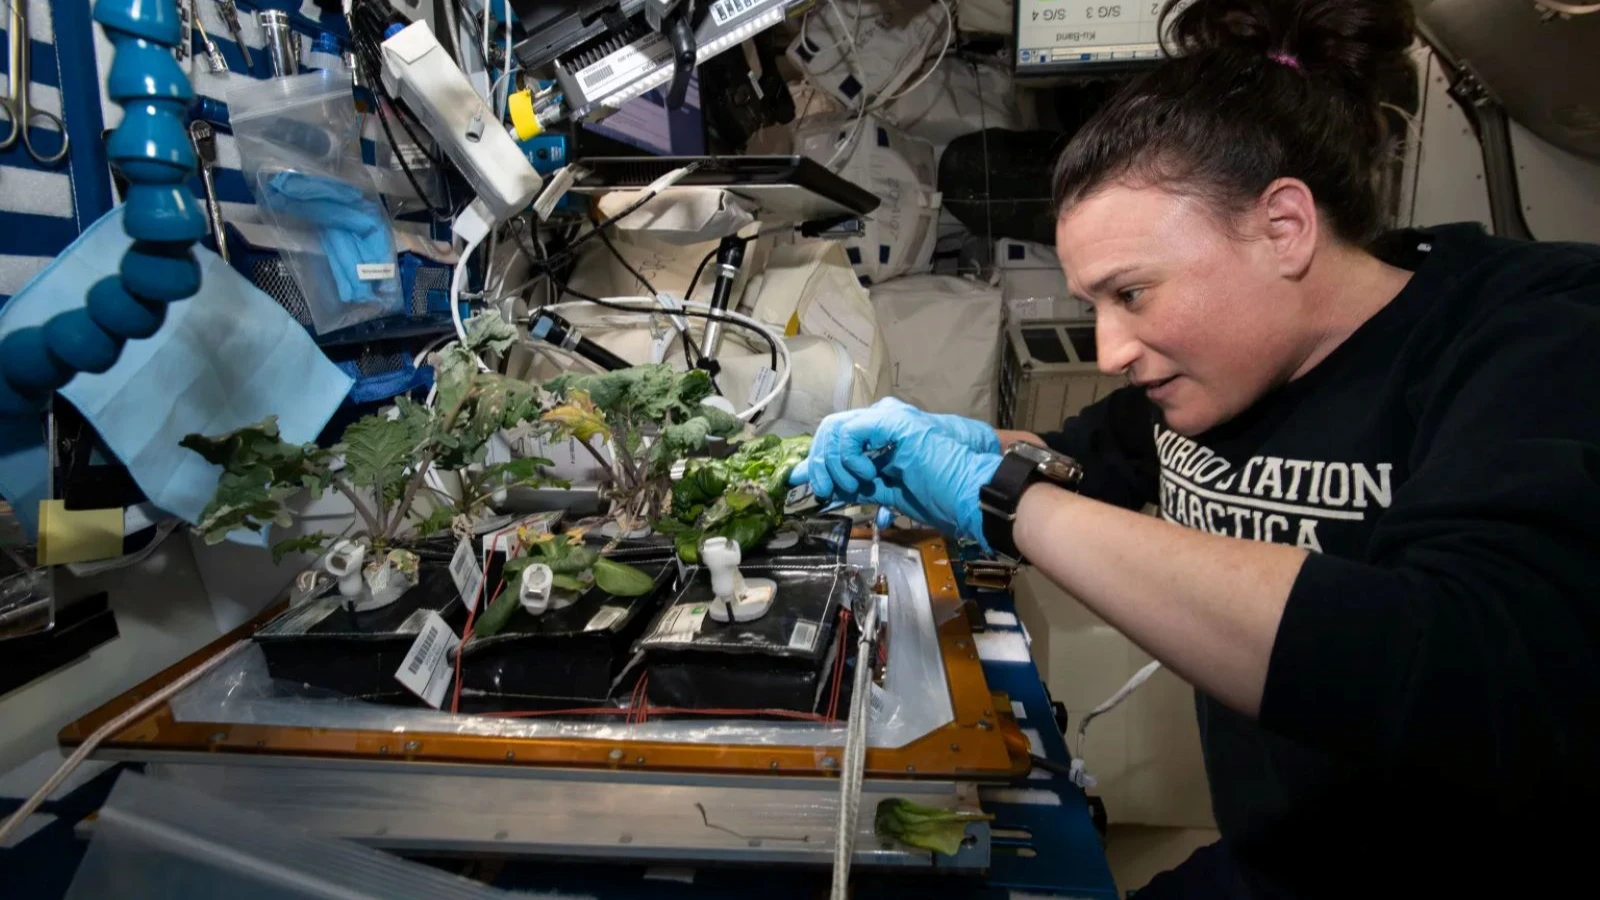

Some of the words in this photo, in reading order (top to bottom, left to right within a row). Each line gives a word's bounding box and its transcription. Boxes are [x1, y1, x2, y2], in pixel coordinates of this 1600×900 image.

[1032, 9, 1039, 21] 4
[1043, 8, 1066, 20] S/G
[1086, 6, 1094, 19] 3
[1098, 5, 1121, 18] S/G
[1151, 3, 1159, 15] 2
[1056, 31, 1096, 42] Ku-Band
